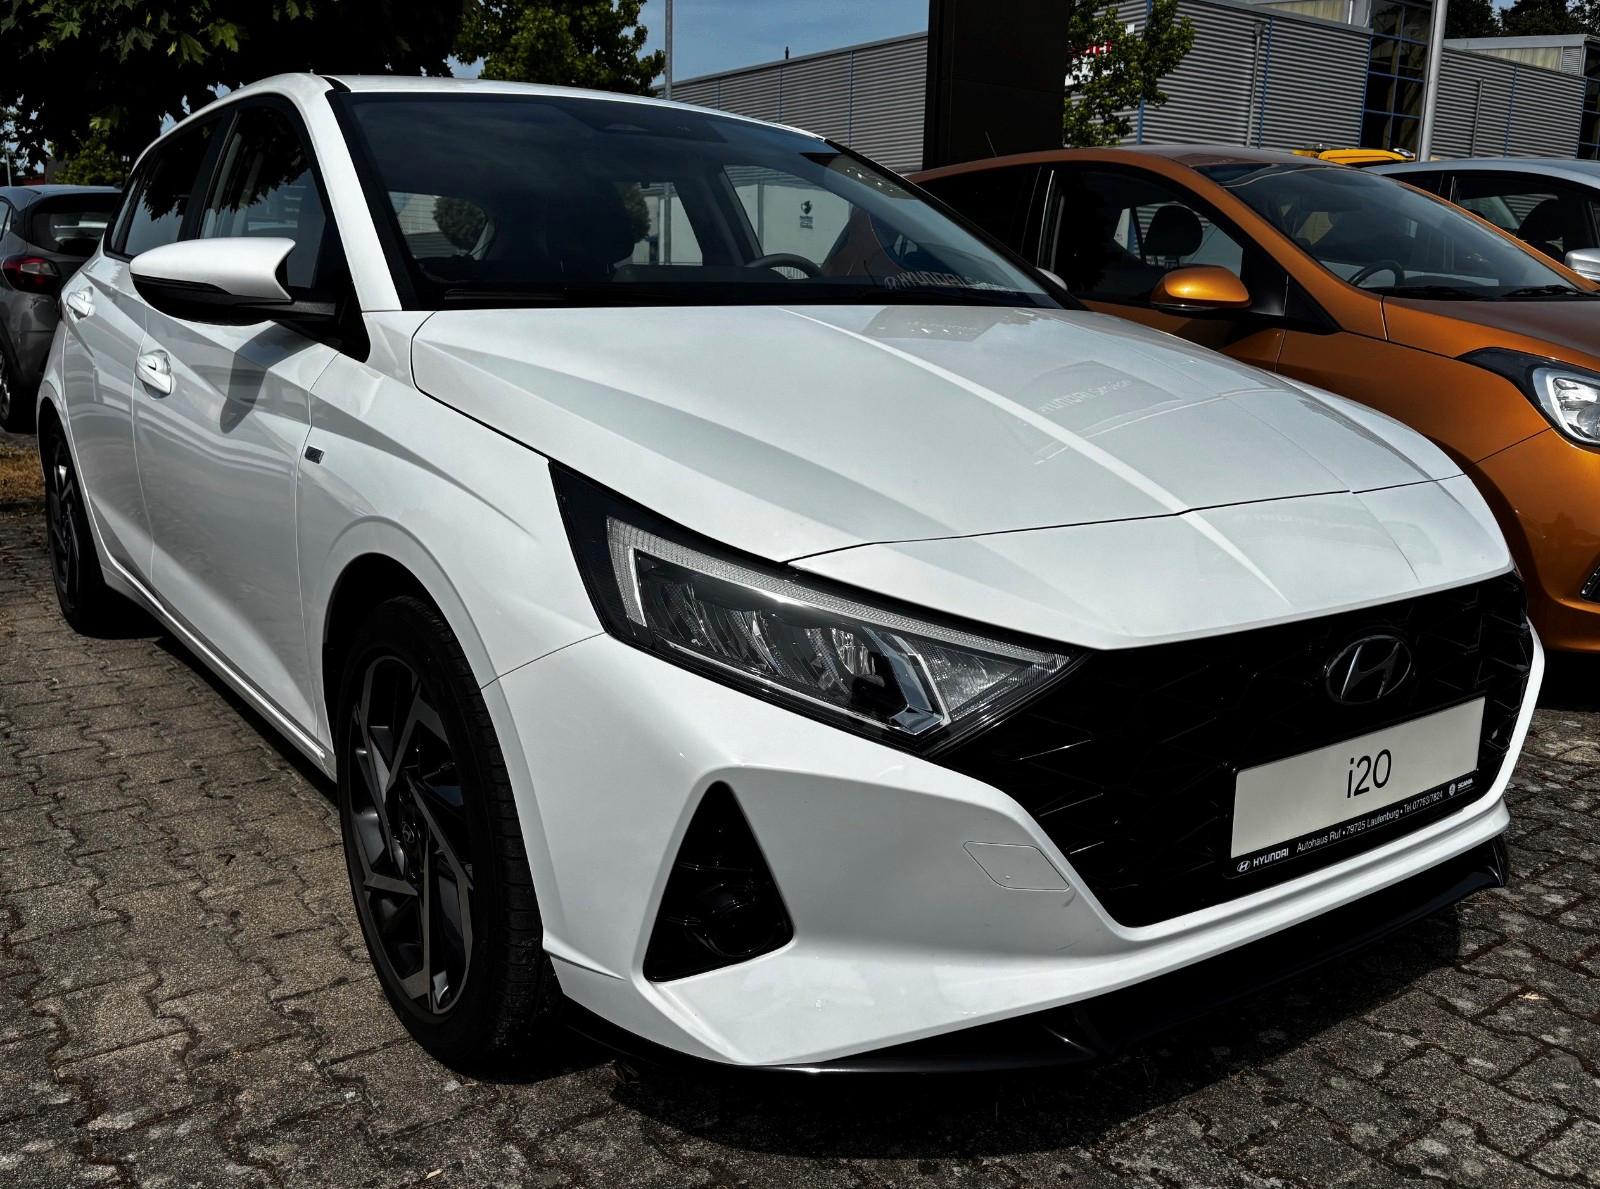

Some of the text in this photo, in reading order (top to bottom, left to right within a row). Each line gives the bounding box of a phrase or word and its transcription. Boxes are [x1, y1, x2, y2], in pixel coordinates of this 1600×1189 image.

[1346, 748, 1392, 799] i20
[1296, 836, 1328, 853] Autohaus
[1329, 828, 1341, 841] Ruf
[1346, 820, 1366, 835] 79725
[1366, 809, 1399, 828] Laufenburg
[1252, 848, 1289, 868] HYUNDAI
